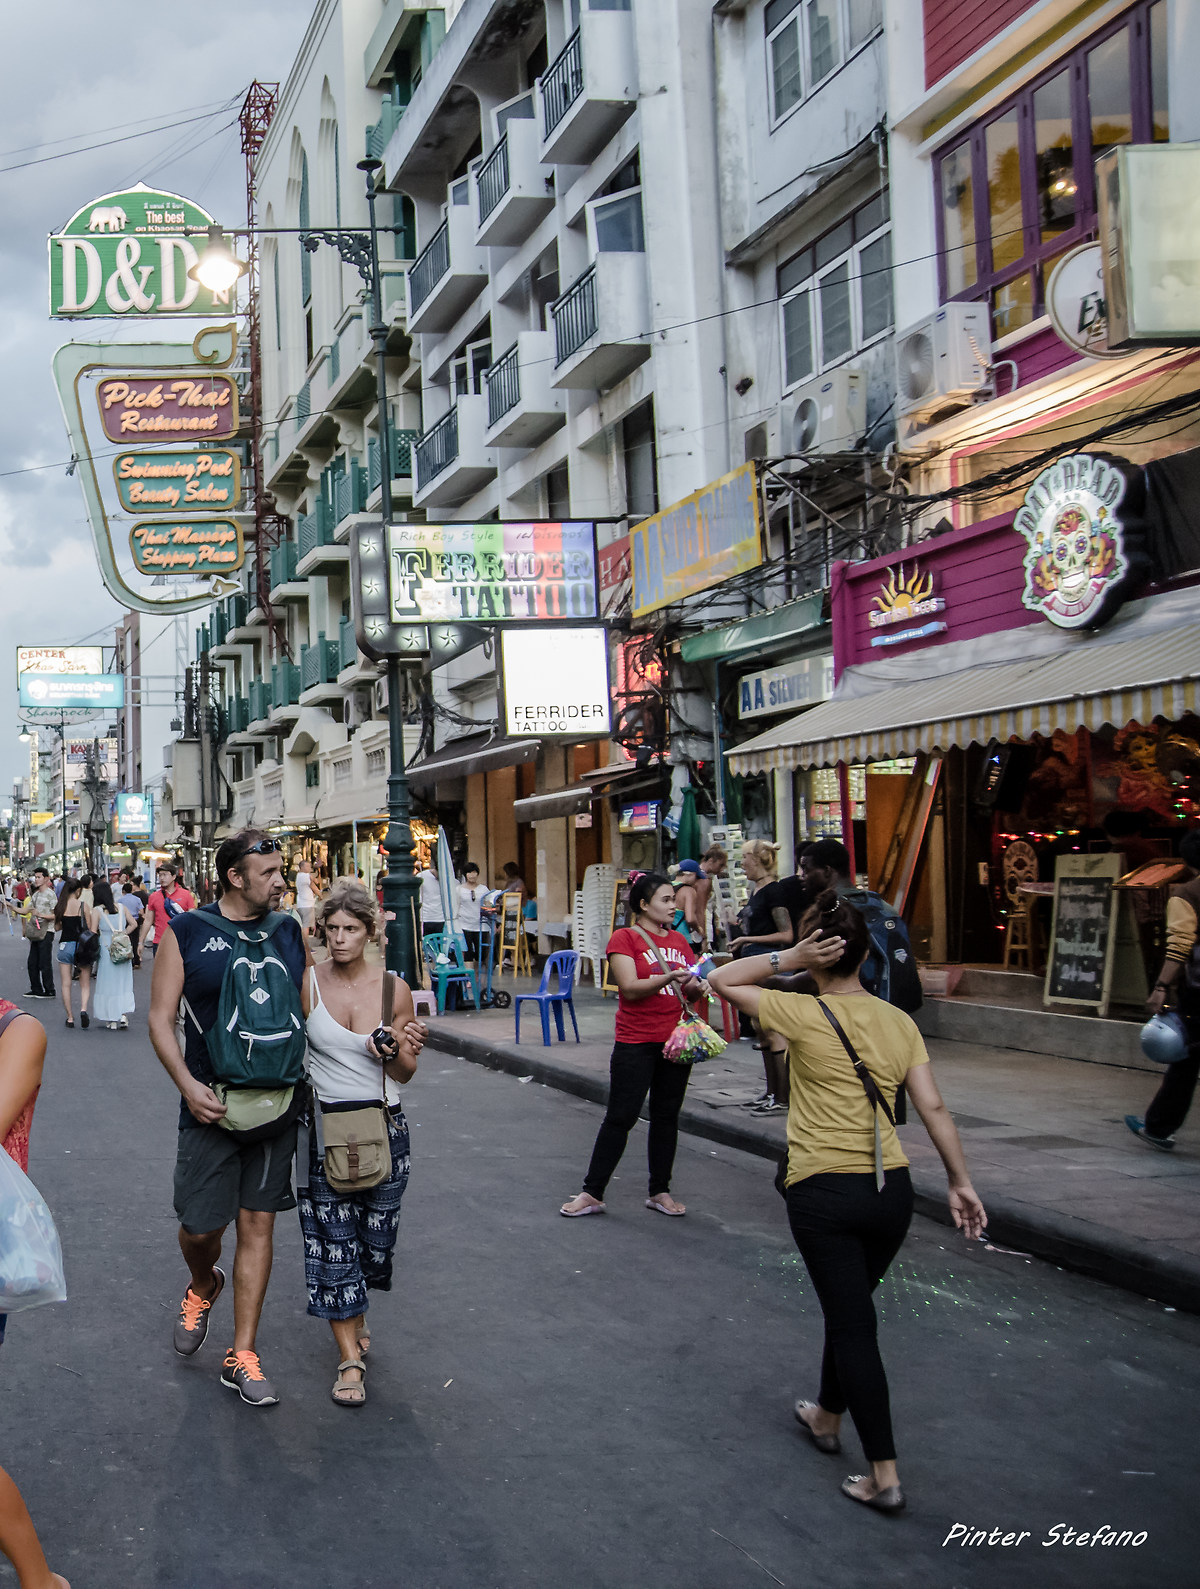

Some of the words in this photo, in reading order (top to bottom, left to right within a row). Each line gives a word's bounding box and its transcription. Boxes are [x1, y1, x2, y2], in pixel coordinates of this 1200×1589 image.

[145, 211, 163, 224] The
[164, 211, 185, 224] best
[56, 237, 201, 313] D&D
[103, 381, 230, 410] Pick-Thai
[120, 410, 218, 433] Restaurant
[119, 456, 196, 481] Swimming
[196, 455, 233, 476] Pool
[128, 482, 180, 508] Beauty
[184, 480, 229, 502] Salon
[134, 528, 170, 547] Thai
[170, 527, 236, 547] Massage
[400, 531, 426, 541] Rich
[432, 531, 454, 543] Boy
[462, 531, 494, 541] Style
[141, 547, 197, 569] Shopping
[198, 545, 237, 563] Plaza
[392, 547, 593, 617] FERRIDER
[452, 582, 595, 618] TATTOO
[20, 649, 66, 660] CENTER
[769, 671, 813, 706] SILVER
[26, 707, 93, 719] Shamrock
[514, 704, 604, 719] FERRIDER
[515, 720, 567, 732] TATTOO
